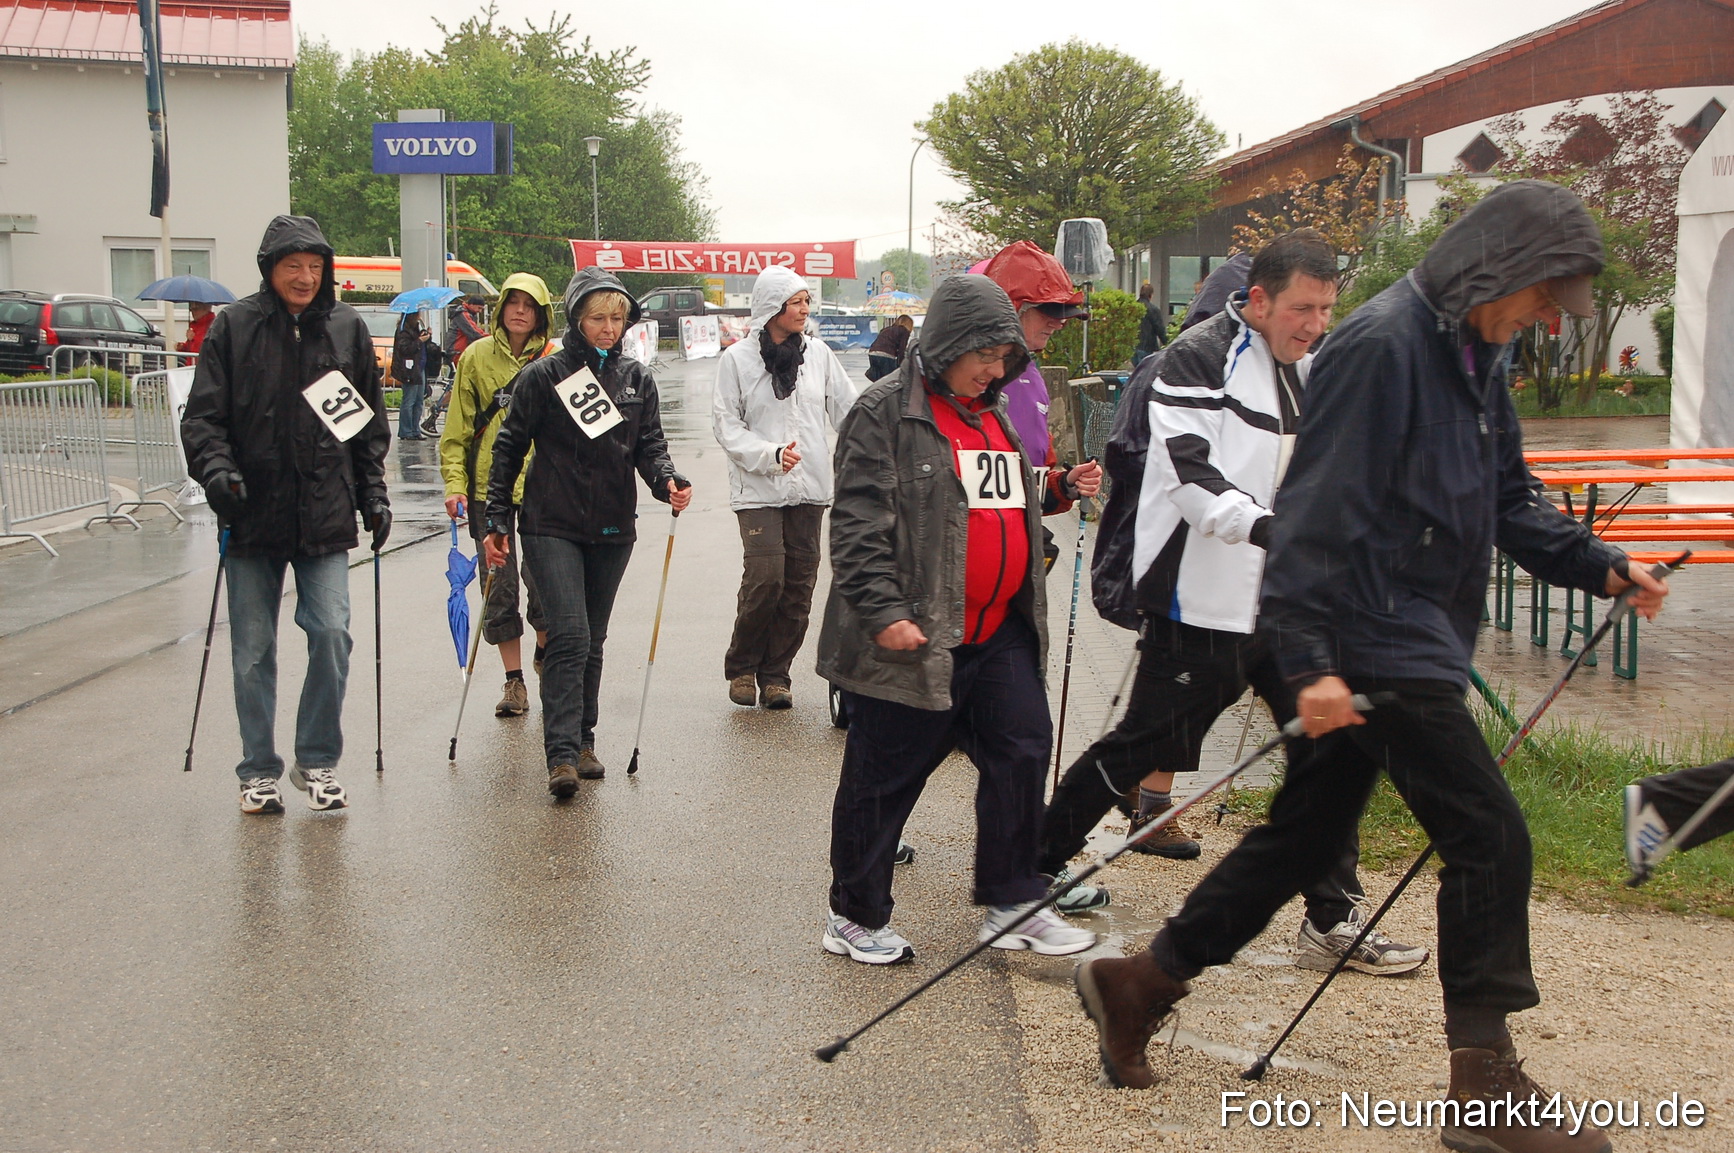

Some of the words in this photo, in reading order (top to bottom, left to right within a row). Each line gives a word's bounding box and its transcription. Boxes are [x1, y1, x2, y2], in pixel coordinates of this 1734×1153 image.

[383, 136, 477, 157] VOLVO
[321, 386, 365, 425] 37
[569, 382, 611, 425] 36
[977, 452, 1011, 500] 20
